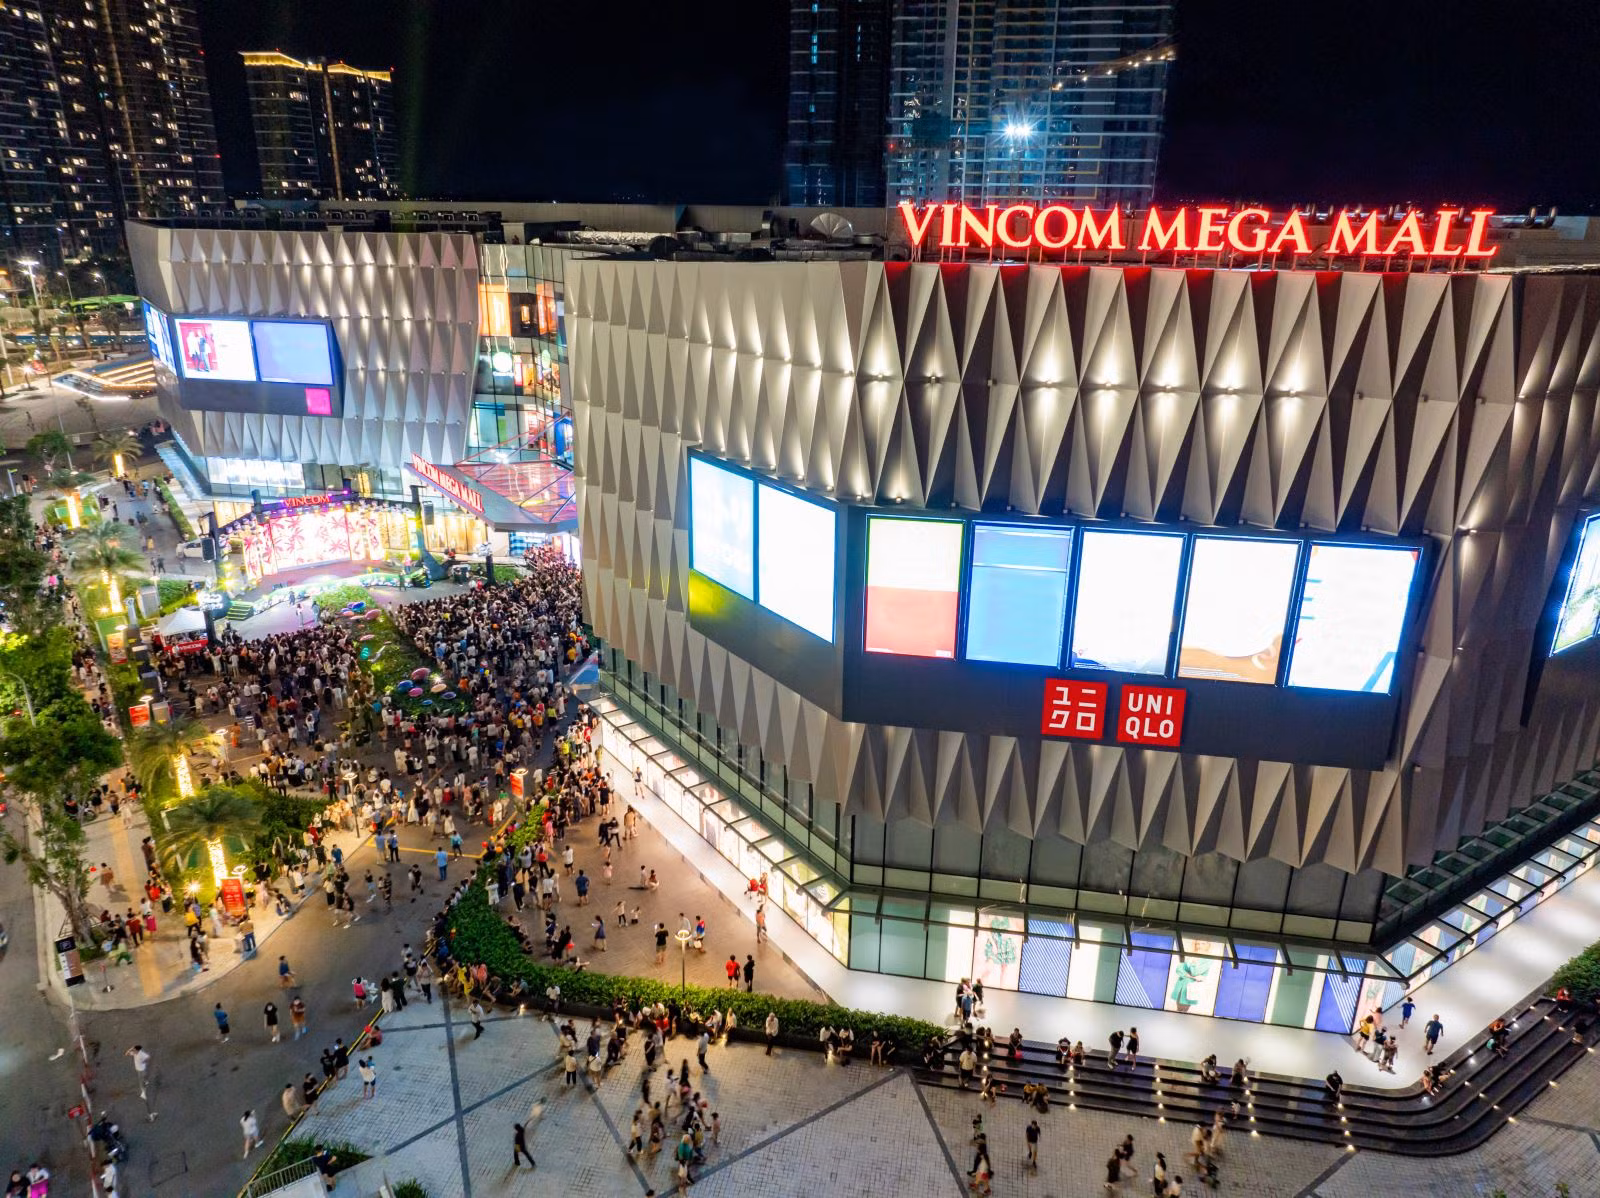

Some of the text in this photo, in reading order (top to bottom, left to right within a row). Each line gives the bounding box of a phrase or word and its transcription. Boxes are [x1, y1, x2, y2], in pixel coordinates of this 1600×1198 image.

[899, 203, 1498, 257] VINCOM MEGA MALL
[412, 453, 484, 512] VINCOM MEGA MALL
[284, 495, 330, 507] VINCOM
[1052, 686, 1097, 708] ユニ
[1128, 692, 1173, 715] UNI
[1048, 710, 1096, 732] クロ
[1125, 716, 1175, 739] QLO
